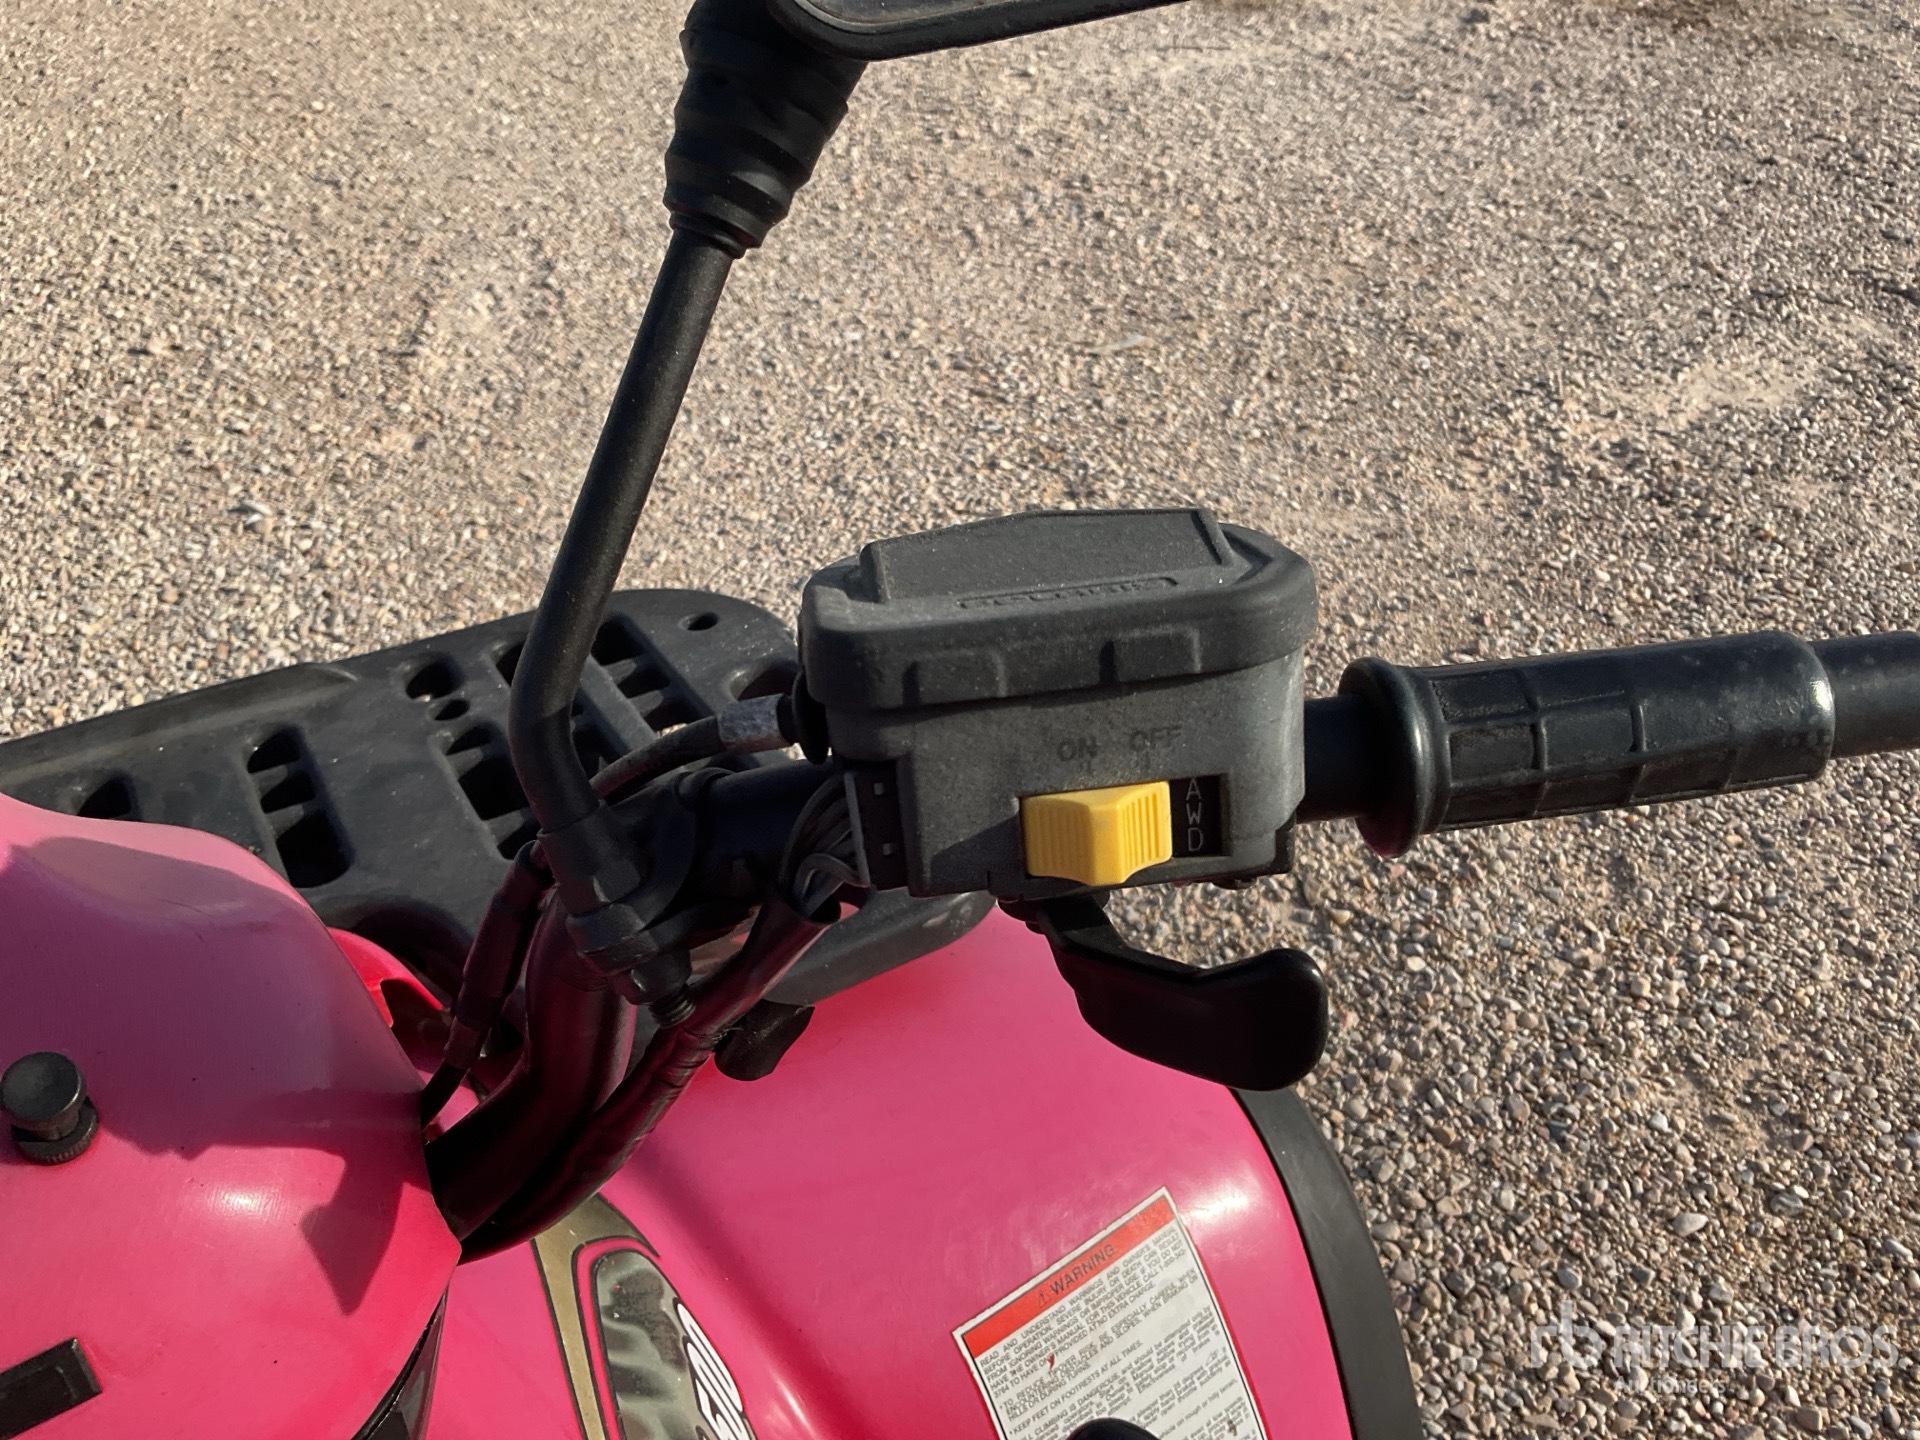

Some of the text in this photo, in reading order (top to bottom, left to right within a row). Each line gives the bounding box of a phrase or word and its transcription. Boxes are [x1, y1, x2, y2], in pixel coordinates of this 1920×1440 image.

[1056, 737, 1099, 762] ON
[1130, 724, 1182, 752] OFF
[1185, 777, 1204, 853] AWD
[983, 1353, 1010, 1375] BEFORE
[1055, 1304, 1081, 1325] SEVERE
[1083, 1286, 1106, 1305] INJURY
[1108, 1276, 1119, 1287] OR
[1120, 1260, 1142, 1278] DEATH
[1143, 1249, 1156, 1262] CAN
[1158, 1233, 1180, 1251] RESULT
[1049, 1243, 1115, 1296] WARNING
[979, 1350, 999, 1368] READ
[1002, 1337, 1018, 1352] AND
[1020, 1304, 1065, 1339] UNDERSTAND
[1068, 1278, 1103, 1306] WARNINGS
[1105, 1266, 1120, 1279] AND
[986, 1365, 1007, 1383] FROM
[1009, 1341, 1041, 1367] IGNORING
[1042, 1316, 1078, 1344] WARNINGS
[1079, 1307, 1090, 1318] OR
[1090, 1284, 1123, 1310] IMPROPER
[990, 1374, 1009, 1390] HAVE
[1023, 1341, 1056, 1368] OWNER'S
[1056, 1321, 1085, 1345] MANUAL
[1099, 1299, 1115, 1313] THIS
[1142, 1268, 1158, 1283] CALL
[1009, 1377, 1020, 1387] TO
[1019, 1364, 1038, 1380] HAVE
[1038, 1352, 1055, 1367] ON
[1054, 1330, 1087, 1356] PROVIDED
[1107, 1300, 1128, 1318] EXTRA
[1013, 1418, 1032, 1435] KEEP
[1031, 1406, 1049, 1422] FEET
[1048, 1398, 1060, 1409] ON
[1060, 1370, 1100, 1401] FOOTRESTS
[1099, 1363, 1109, 1373] AT
[1108, 1354, 1121, 1367] ALL
[1015, 1377, 1044, 1400] REDUCE
